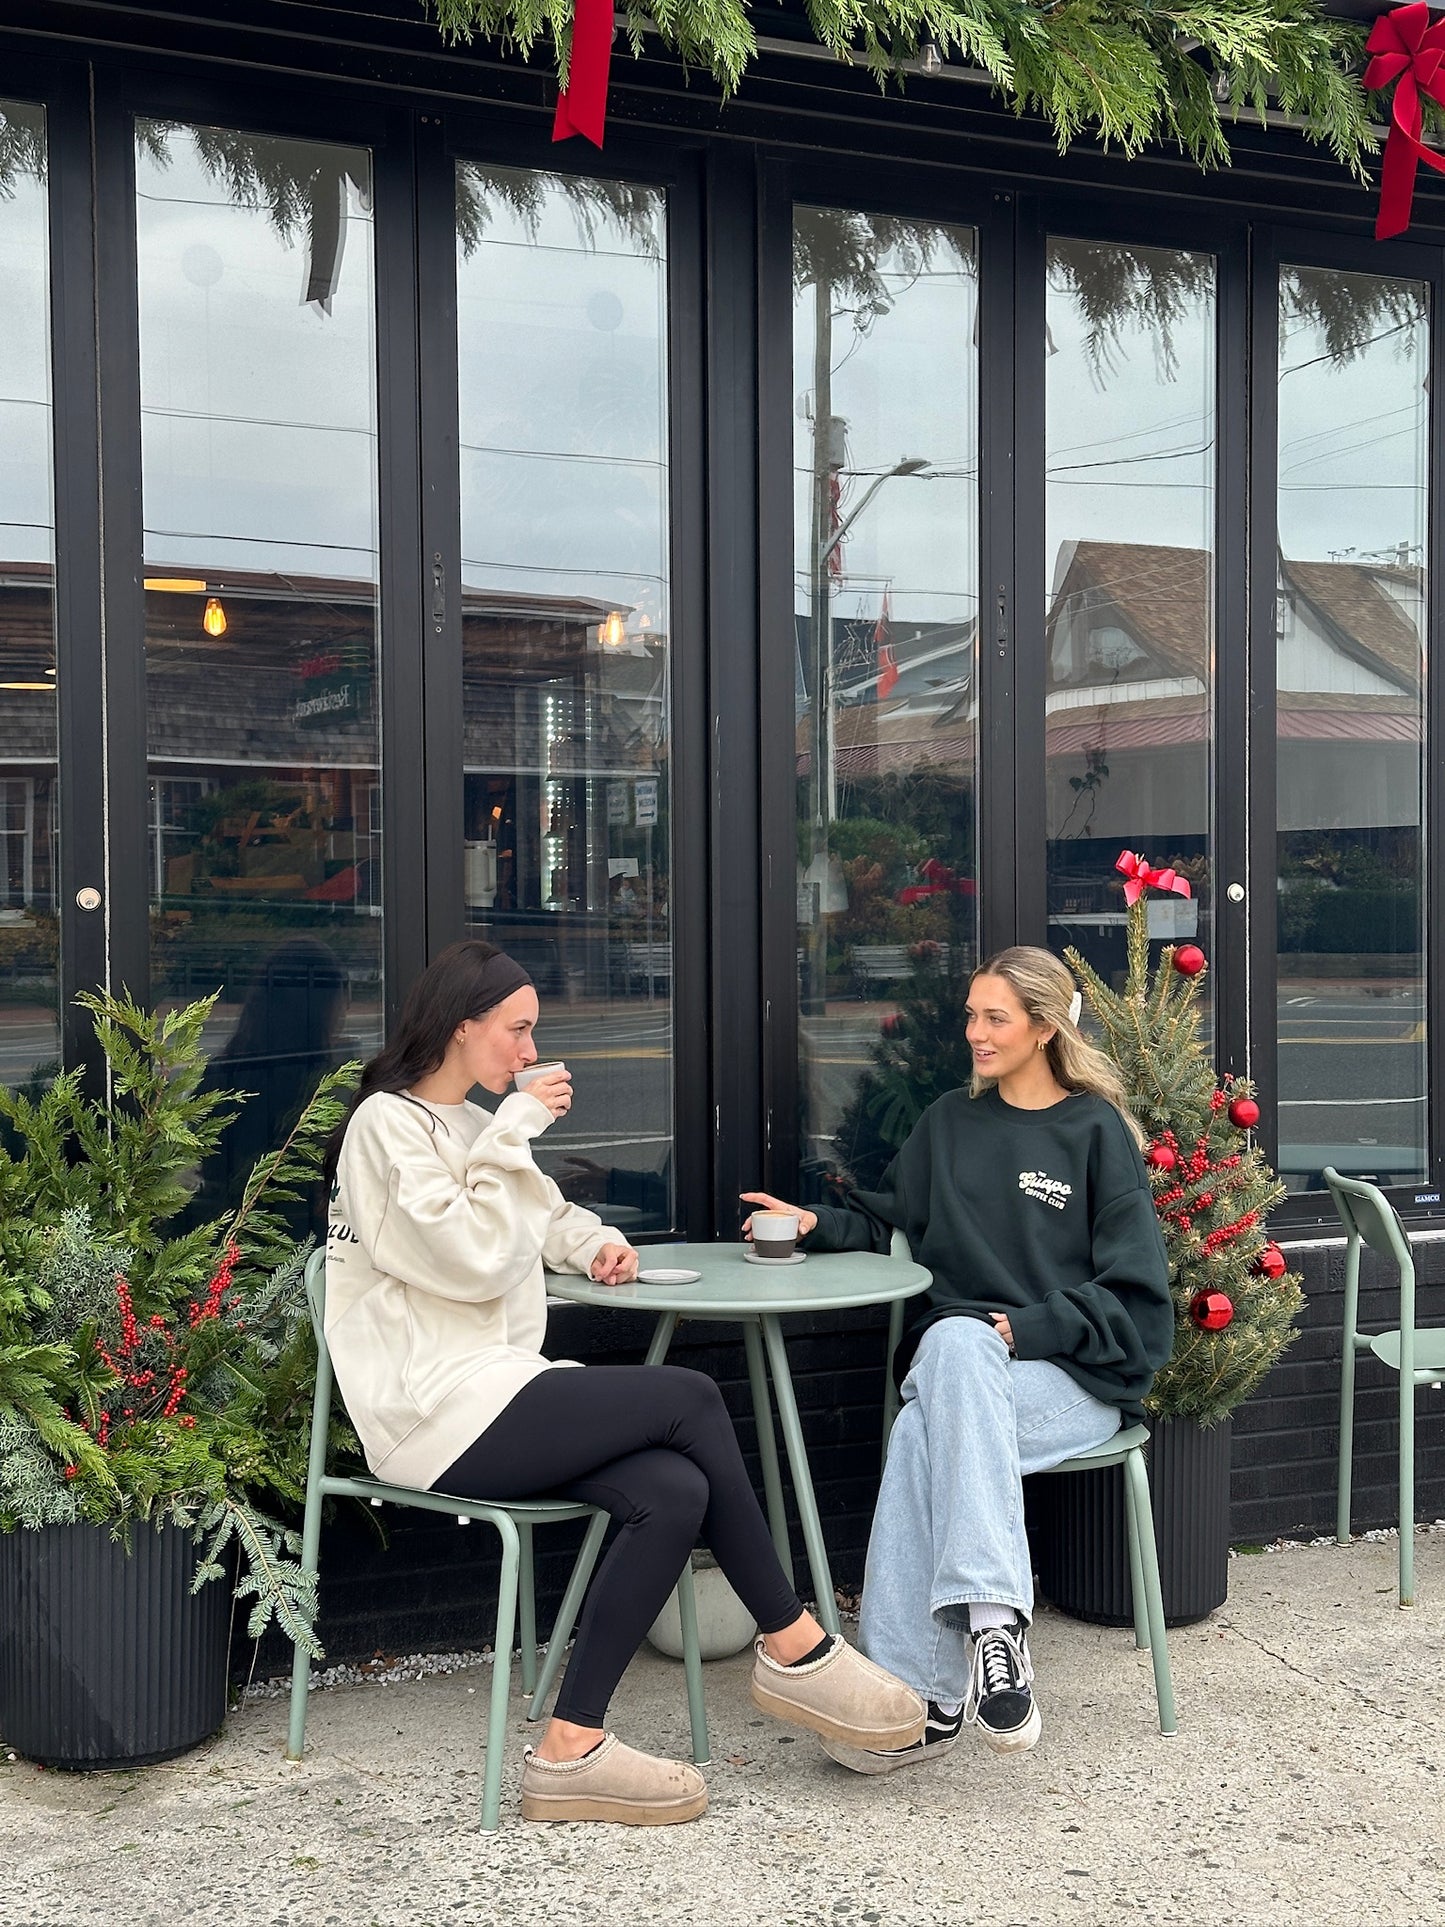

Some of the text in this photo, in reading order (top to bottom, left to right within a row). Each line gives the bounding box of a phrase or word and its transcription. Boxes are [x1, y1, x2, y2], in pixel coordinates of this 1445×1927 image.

[1018, 1171, 1073, 1195] Guapo
[1025, 1187, 1049, 1202] COFFEE
[1047, 1197, 1066, 1210] CLUB
